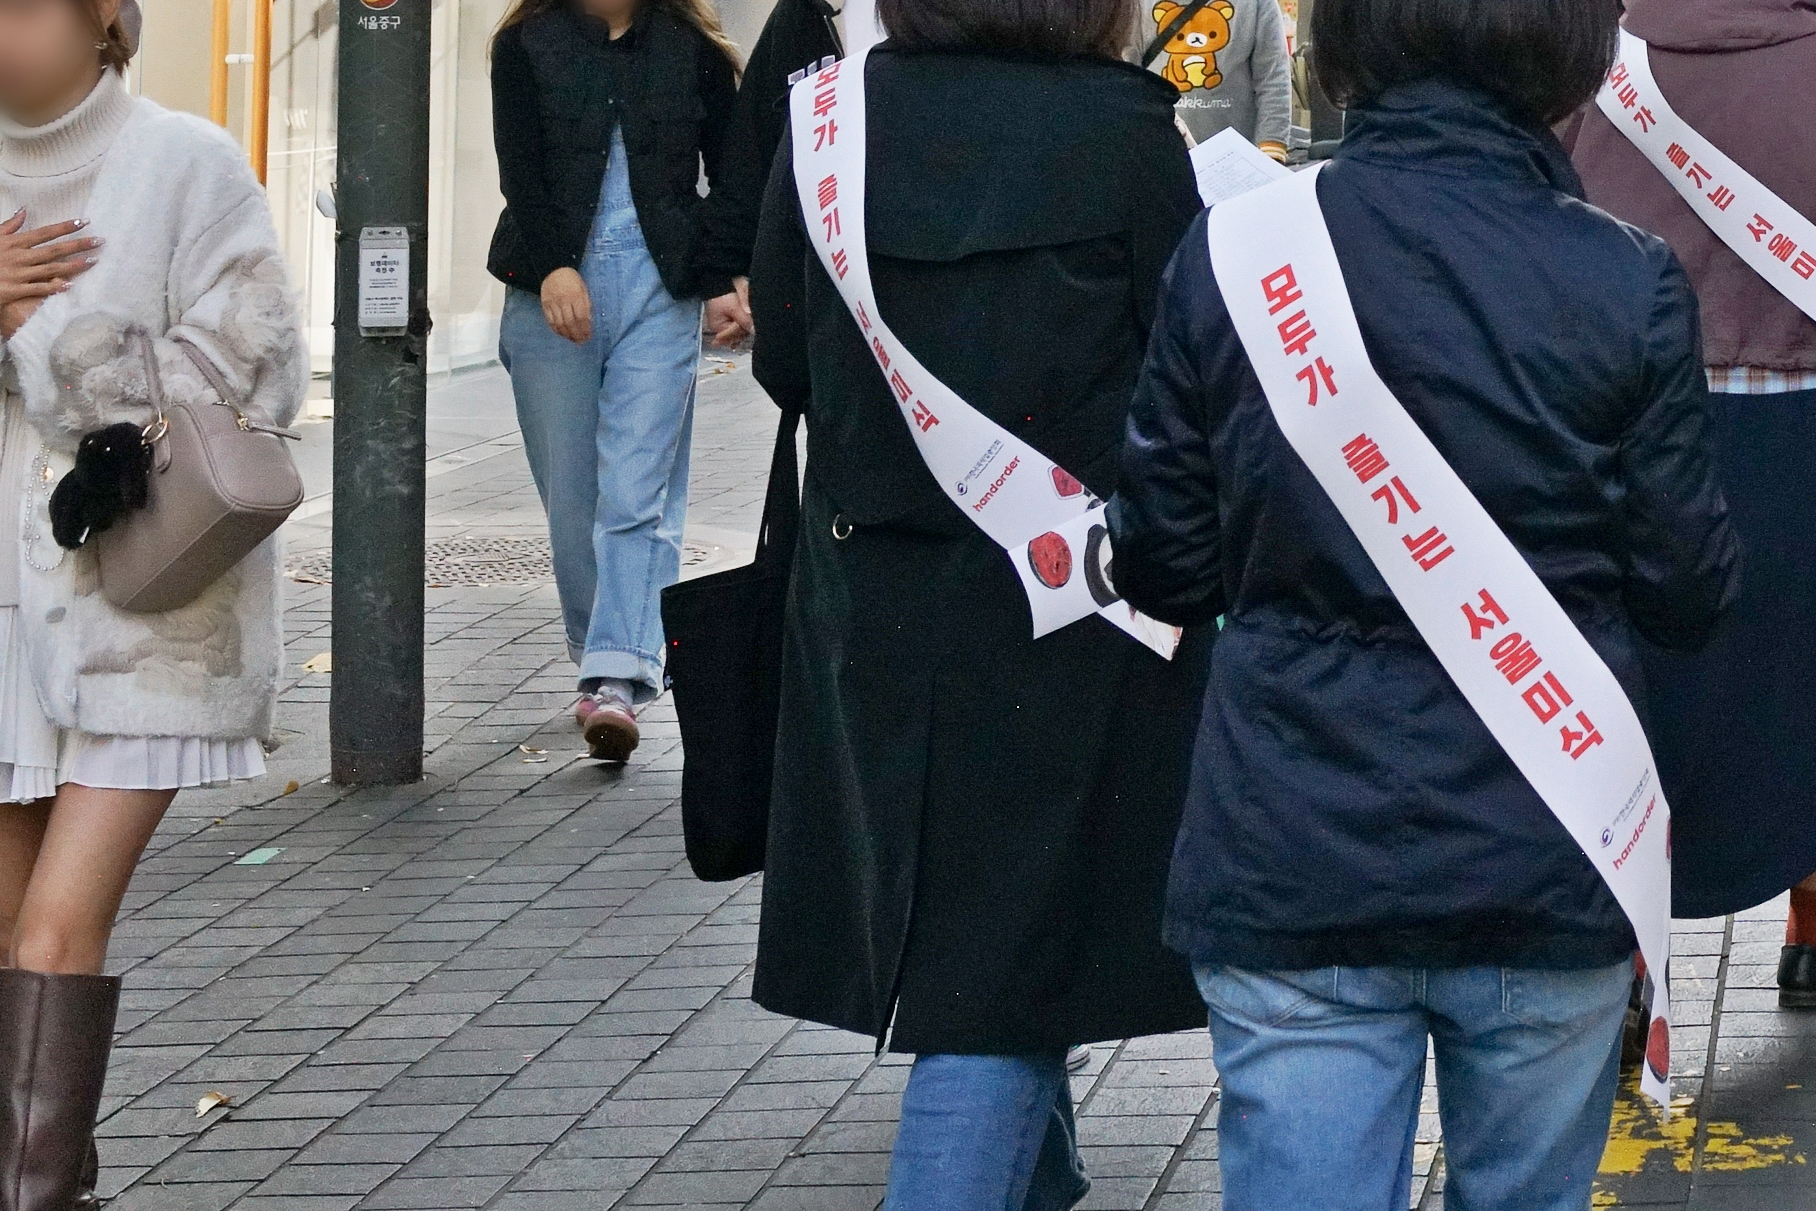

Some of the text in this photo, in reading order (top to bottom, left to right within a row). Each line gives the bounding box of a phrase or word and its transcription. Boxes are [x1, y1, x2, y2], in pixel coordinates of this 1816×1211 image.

[357, 15, 401, 30] 서울중구
[813, 61, 841, 153] 모두가
[1607, 62, 1657, 133] 모두가
[1665, 142, 1736, 212] 즐기는
[817, 173, 849, 280] 즐기는
[972, 454, 1022, 514] handorder
[1261, 264, 1605, 761] 모두가 즐기는 서울미식
[1612, 795, 1658, 871] handorder
